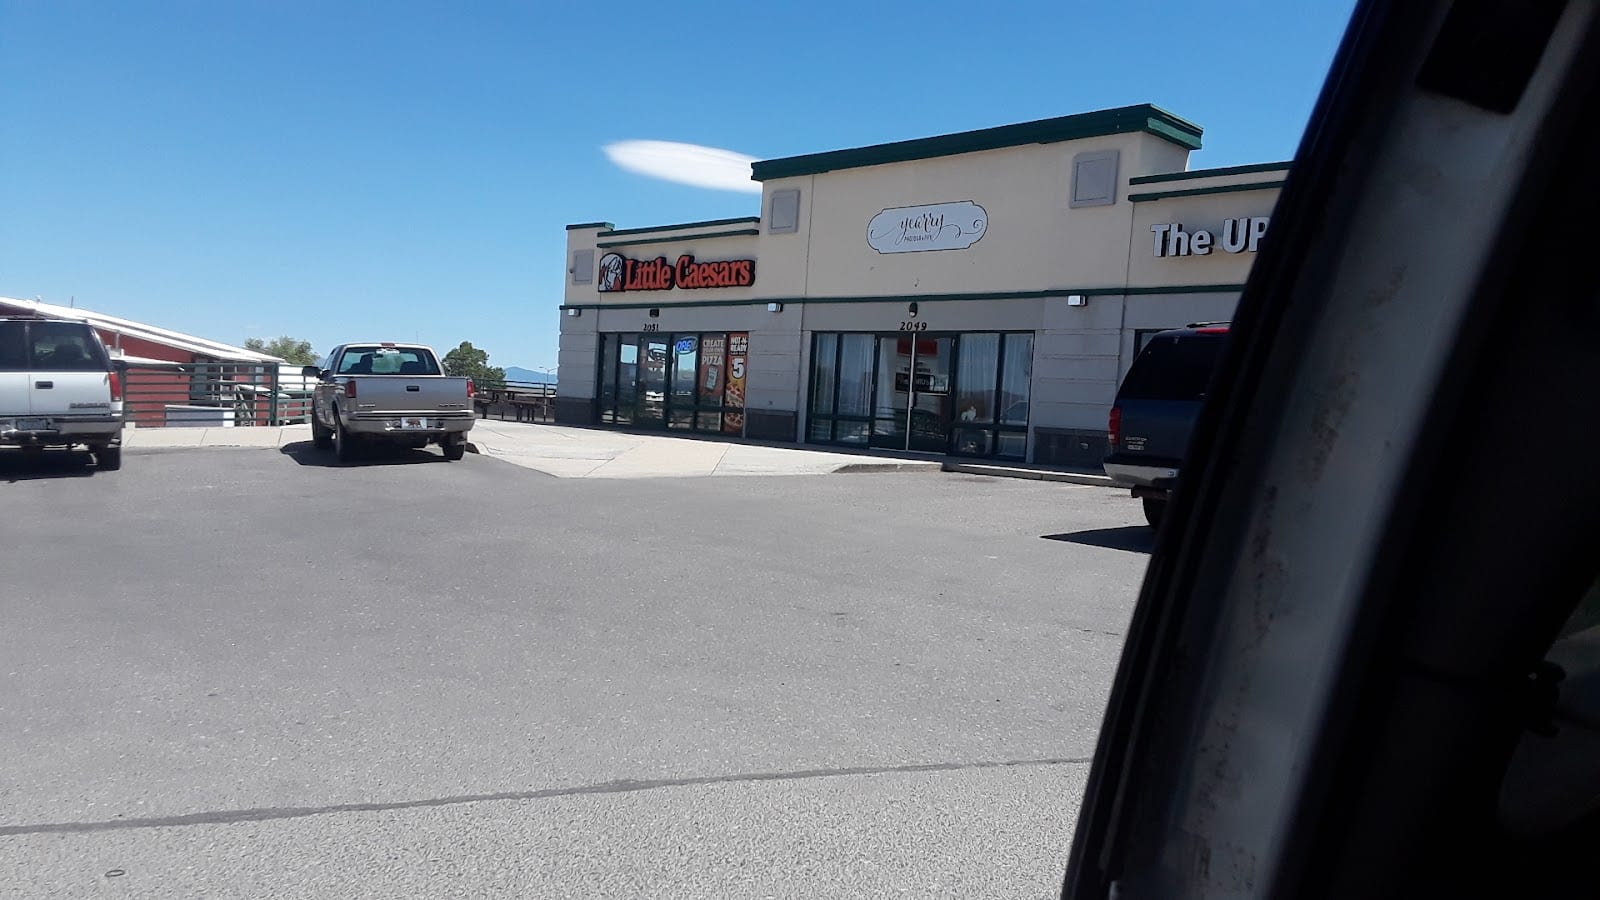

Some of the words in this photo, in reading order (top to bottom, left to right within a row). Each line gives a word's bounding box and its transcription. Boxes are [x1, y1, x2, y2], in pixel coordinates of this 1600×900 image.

[1150, 222, 1211, 258] The
[624, 257, 672, 291] Little
[675, 255, 752, 289] Caesars
[643, 323, 659, 332] 2051
[900, 321, 927, 331] 2049
[702, 339, 725, 348] CREATE
[730, 344, 748, 353] READY
[701, 355, 724, 366] PIZZA
[732, 357, 745, 379] 5
